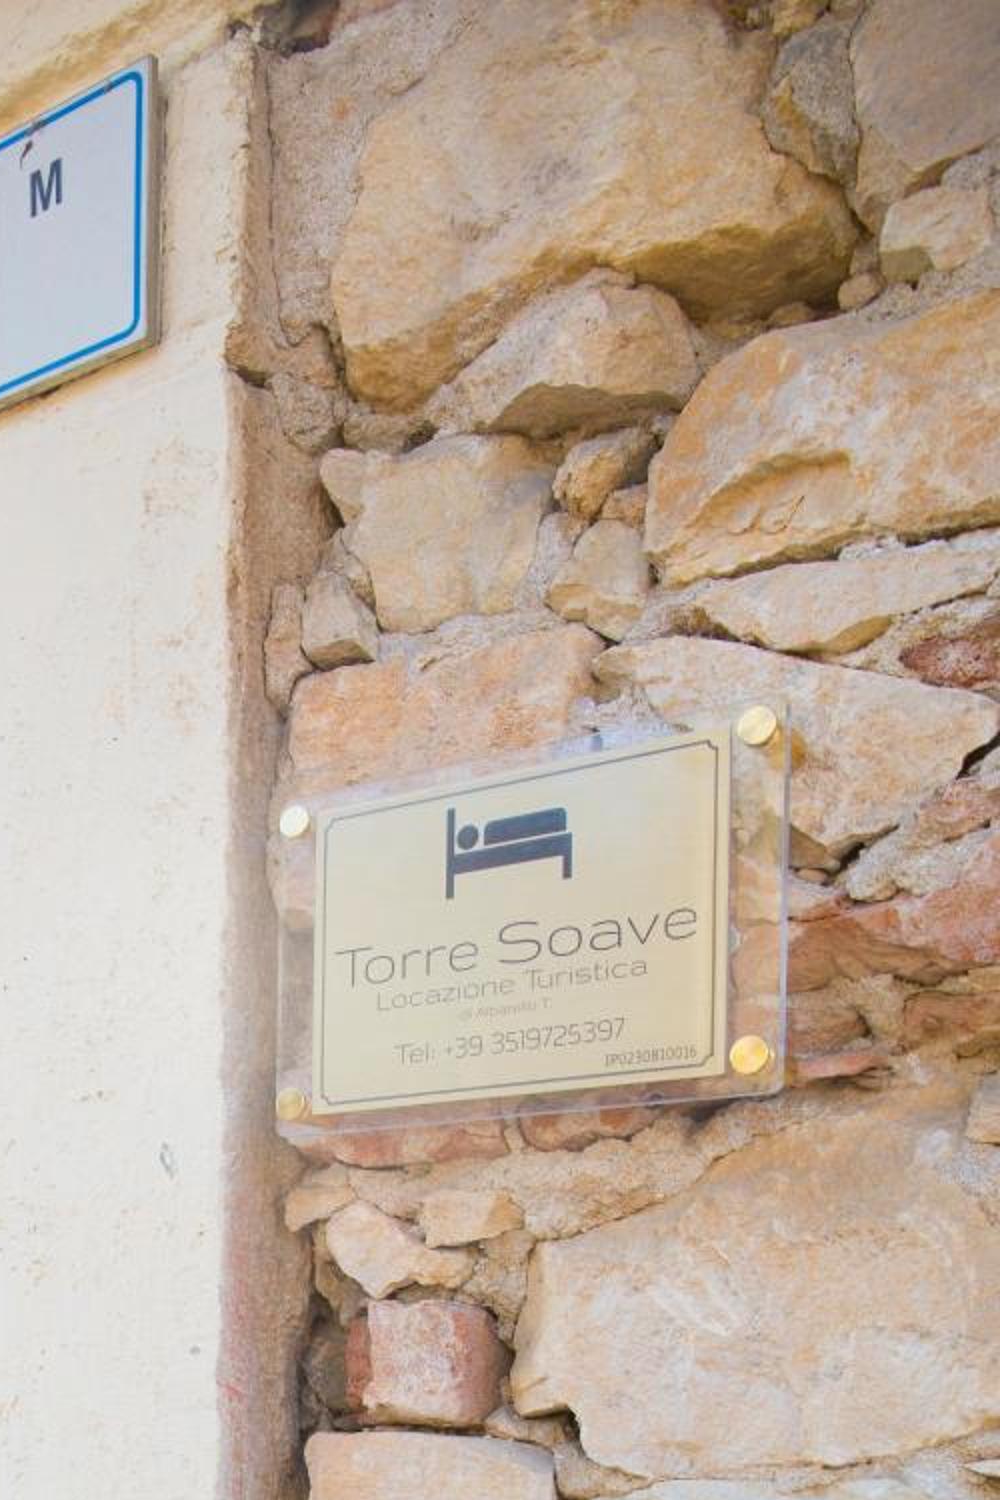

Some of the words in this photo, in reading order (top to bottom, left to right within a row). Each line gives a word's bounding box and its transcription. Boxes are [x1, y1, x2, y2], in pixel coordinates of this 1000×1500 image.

[29, 157, 63, 217] M
[334, 941, 479, 988] Torre
[498, 907, 698, 964] Soave
[375, 976, 516, 1012] Locazione
[522, 959, 649, 990] Turistica
[442, 1034, 483, 1059] +39
[491, 1017, 626, 1056] 3519725397
